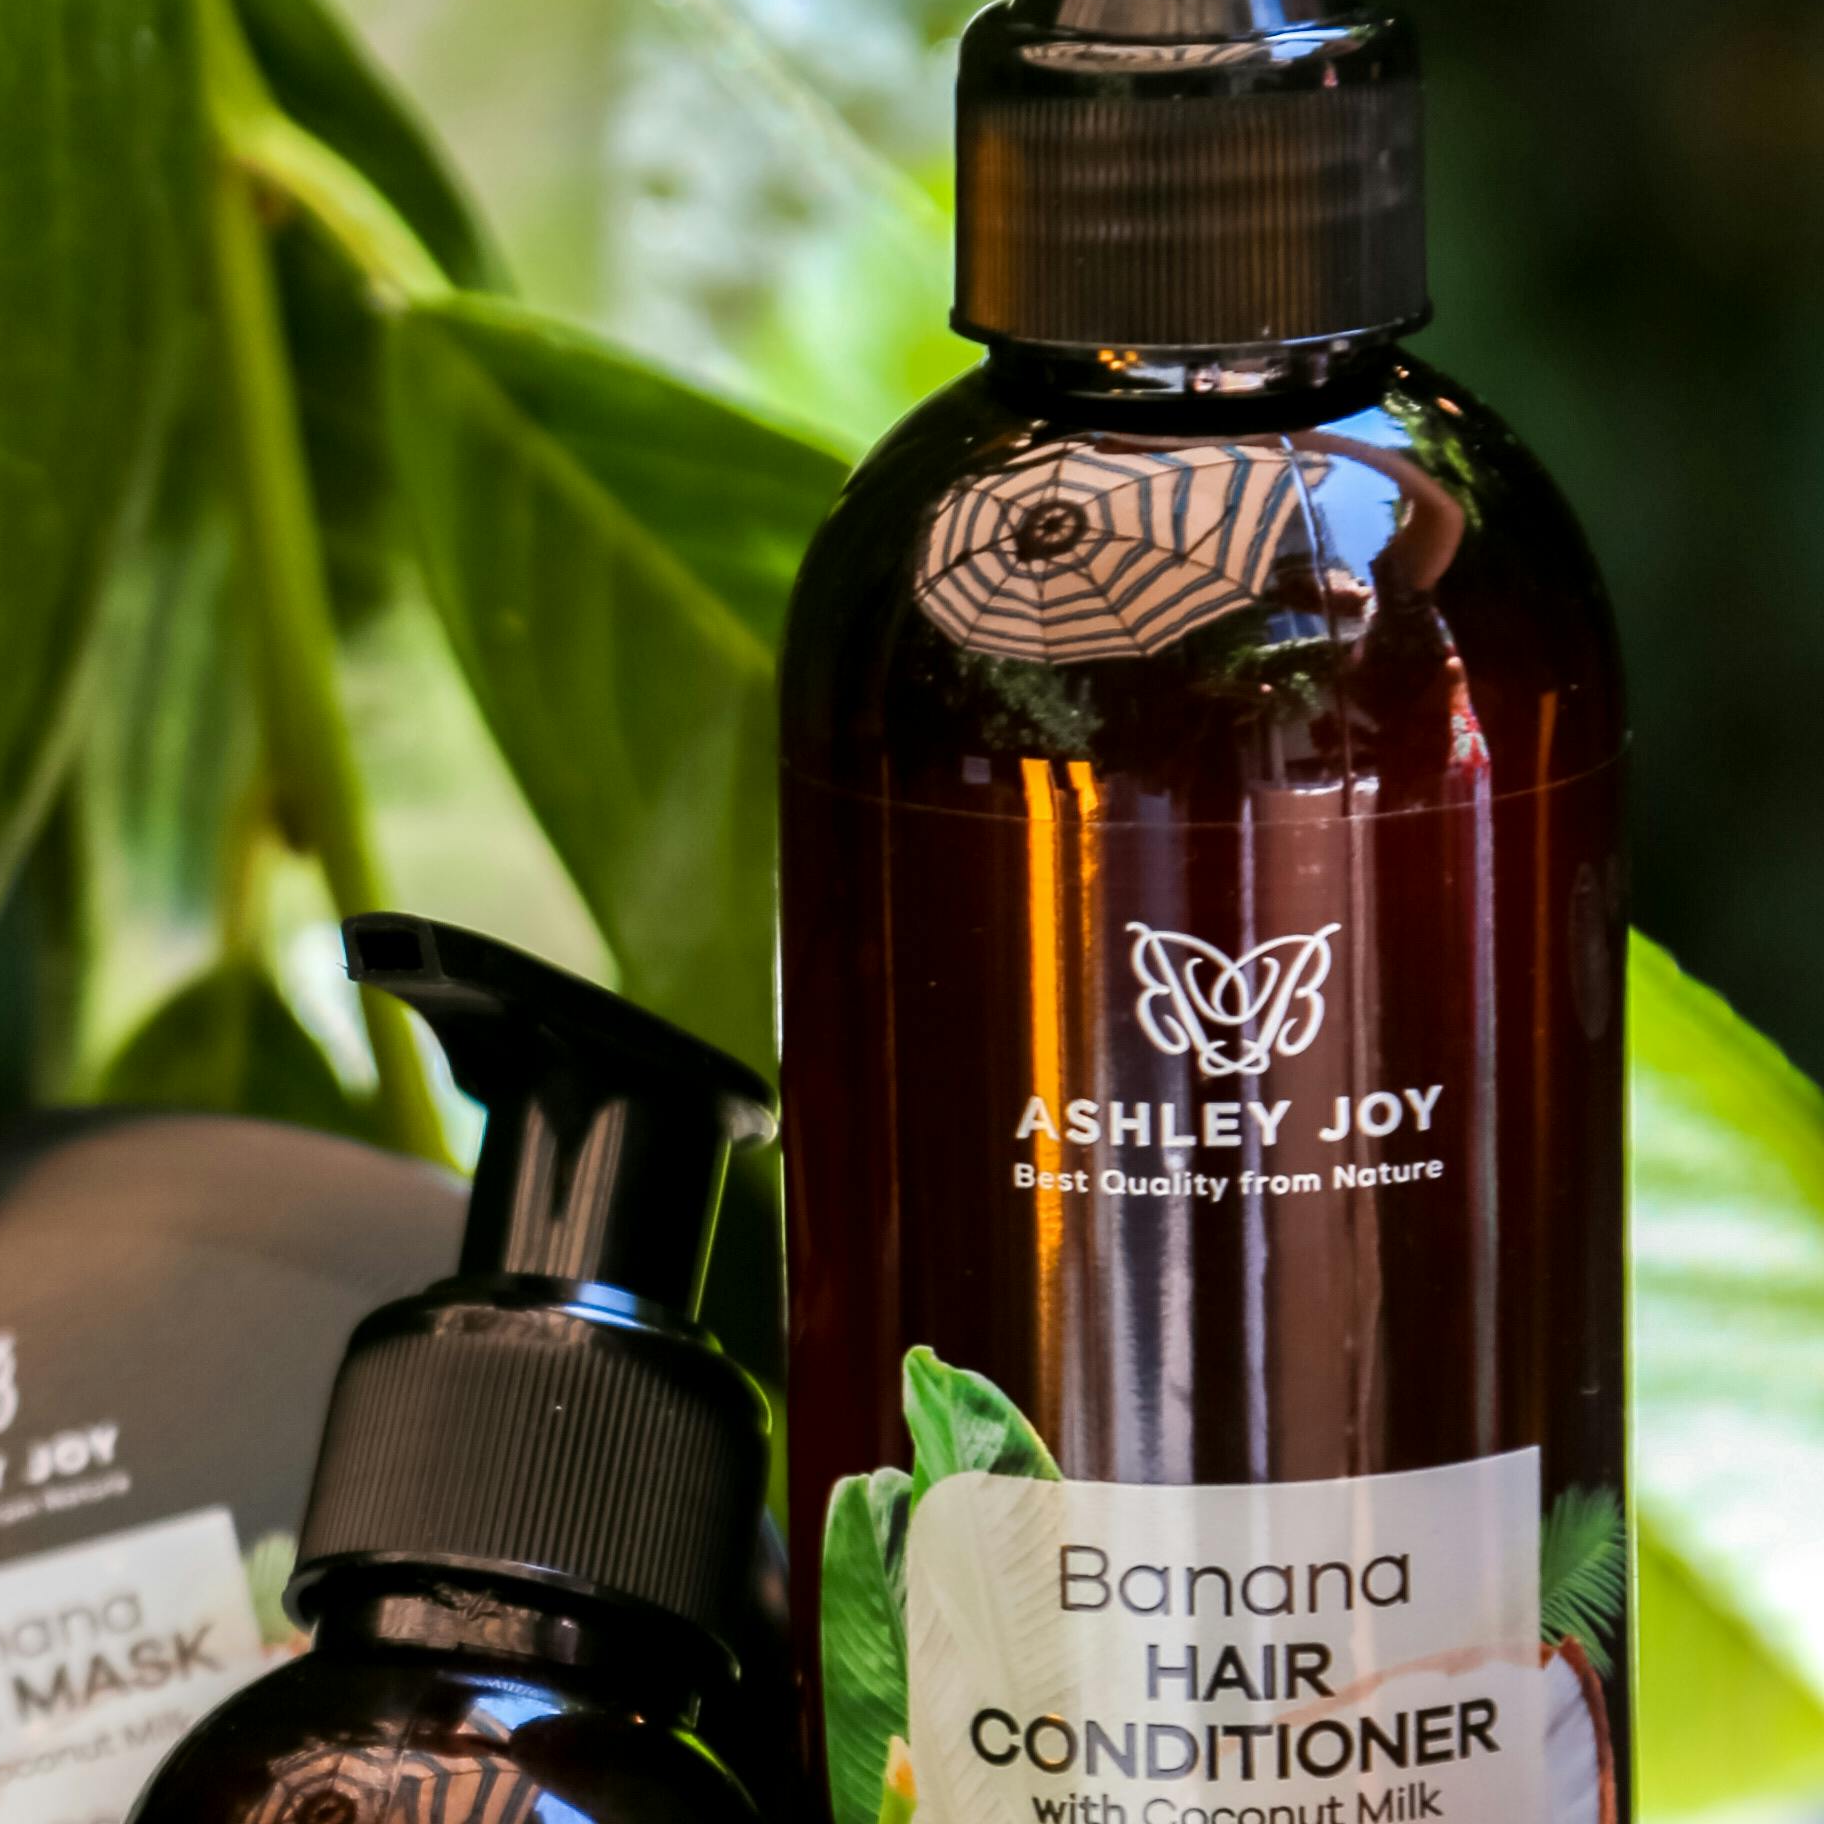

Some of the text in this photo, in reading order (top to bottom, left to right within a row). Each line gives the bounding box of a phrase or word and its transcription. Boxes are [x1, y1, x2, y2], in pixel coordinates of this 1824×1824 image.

[1015, 1085, 1445, 1148] ASHLEY JOY
[1014, 1156, 1445, 1202] Best Quality from Nature
[26, 1422, 118, 1484] JOY
[1059, 1545, 1410, 1615] Banana
[13, 1622, 223, 1722] MASK
[1146, 1642, 1335, 1701] HAIR
[970, 1698, 1501, 1782] CONDITIONER
